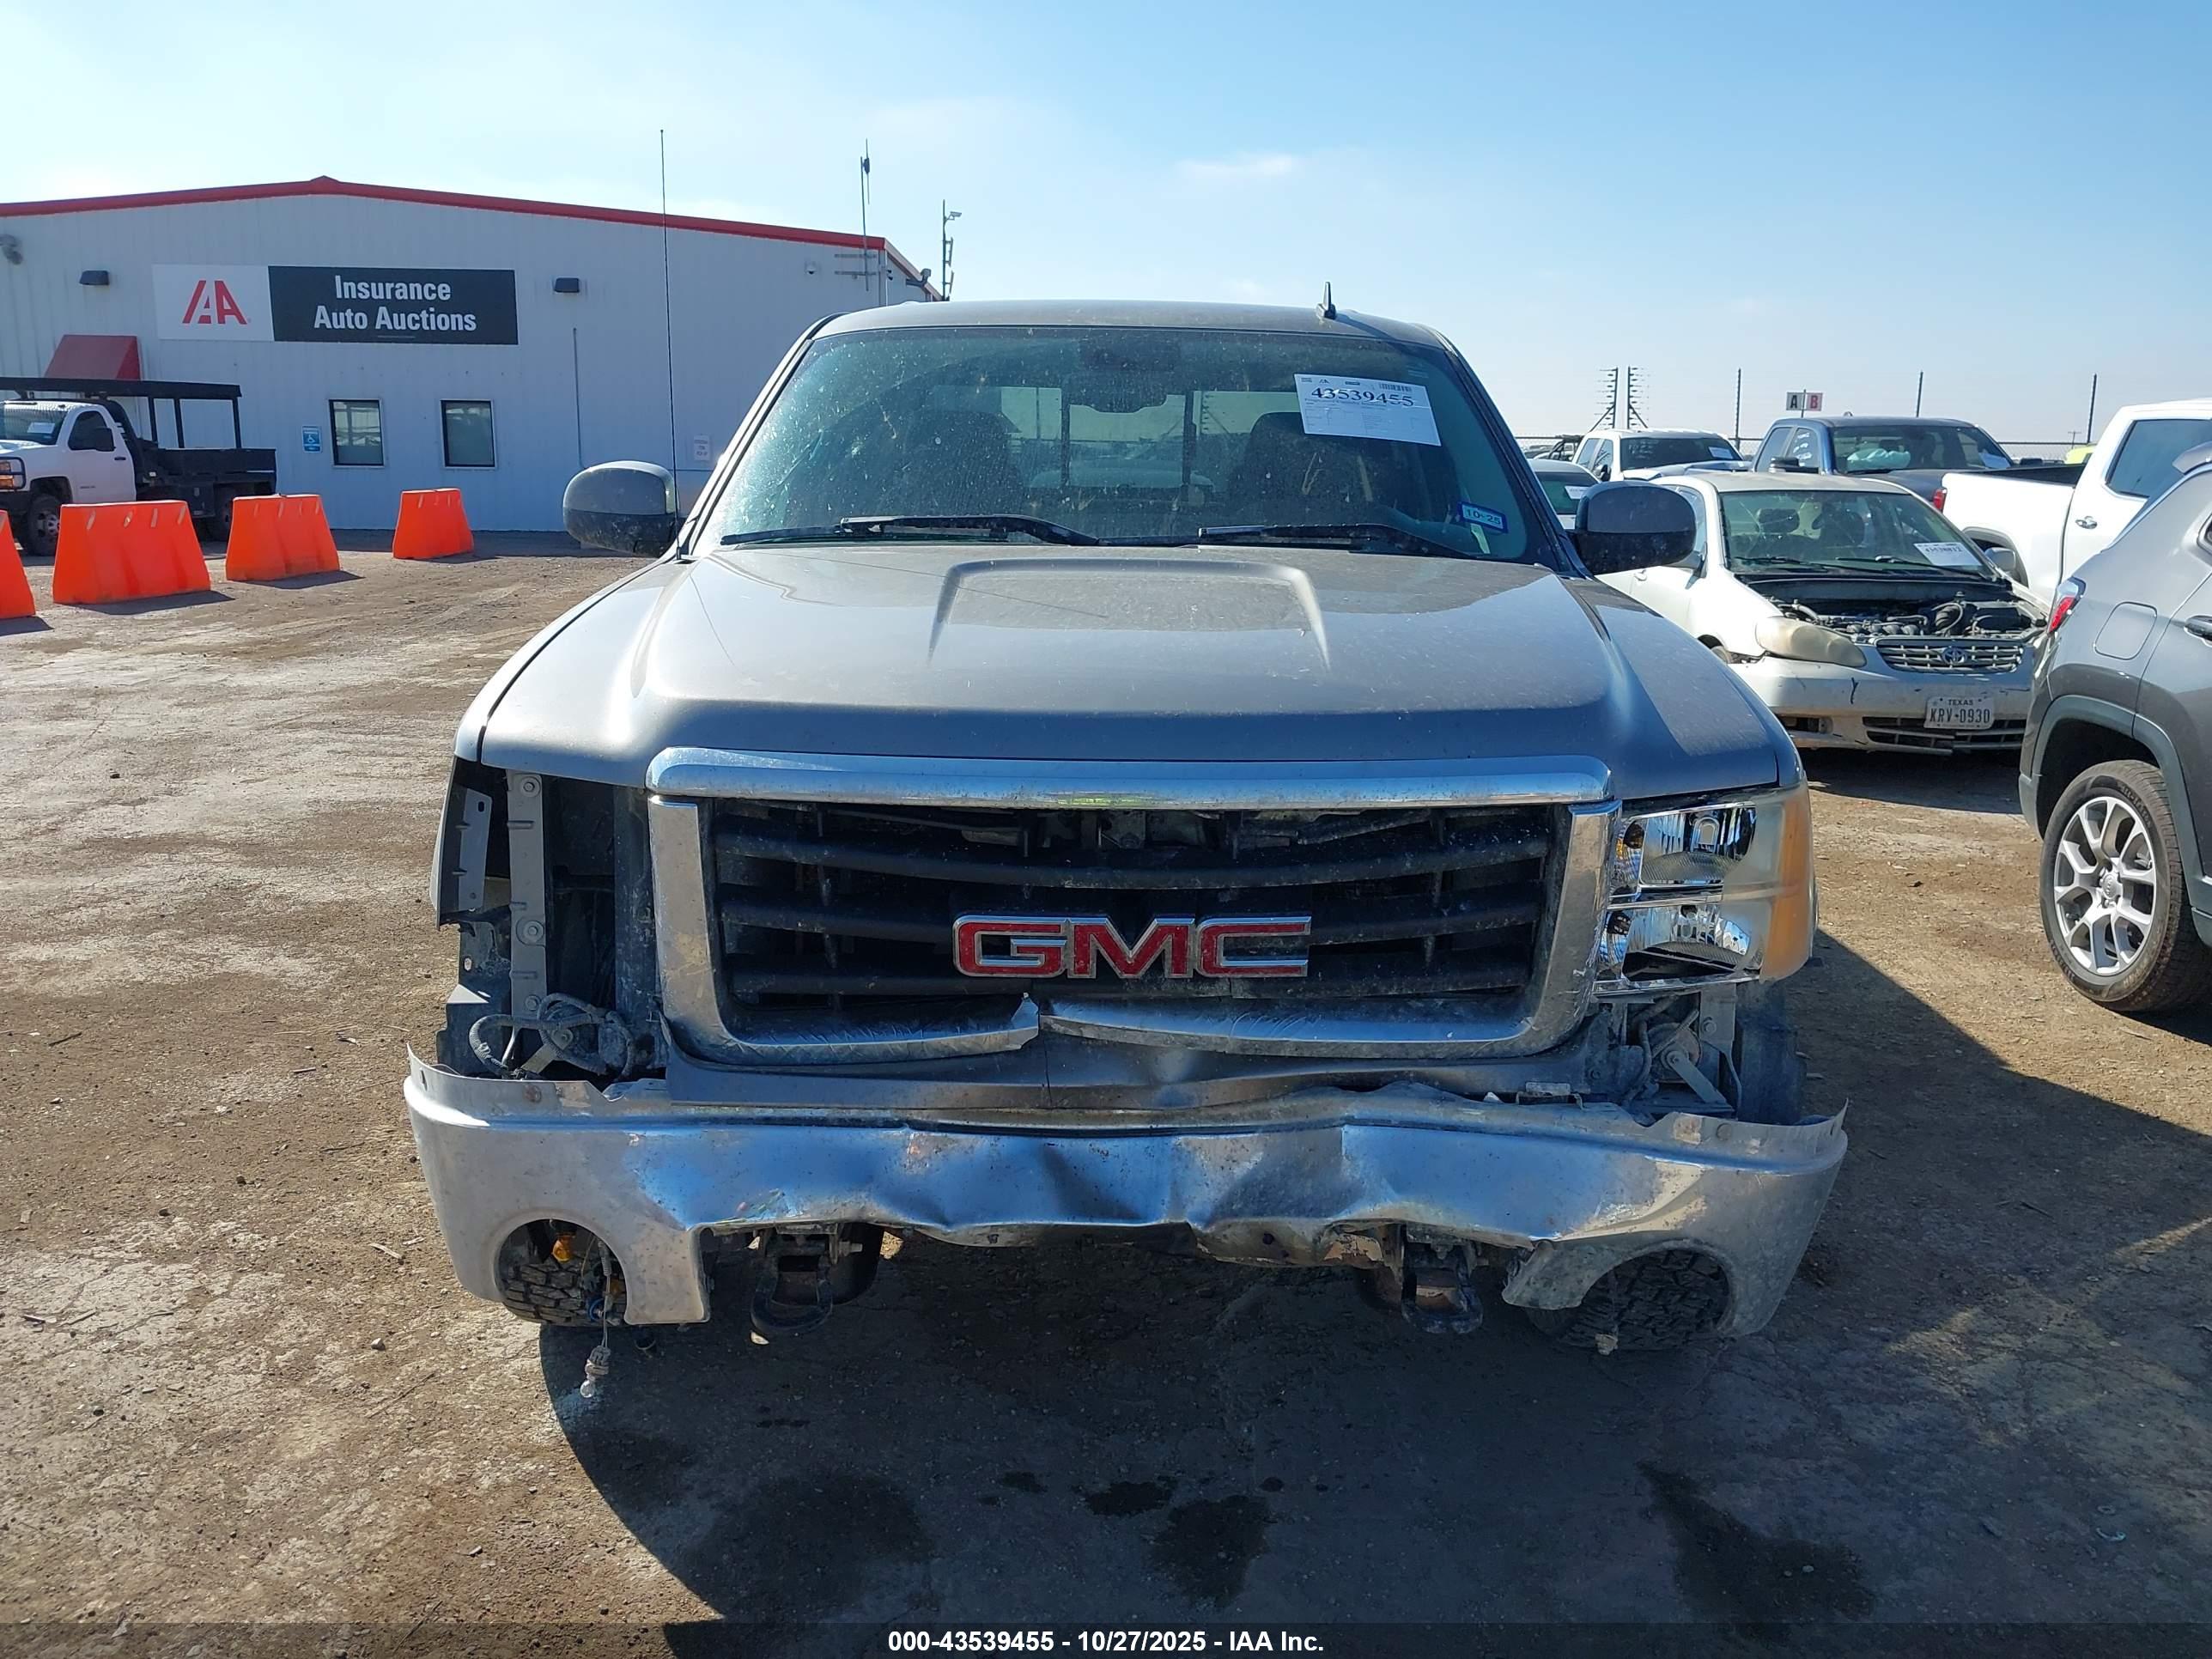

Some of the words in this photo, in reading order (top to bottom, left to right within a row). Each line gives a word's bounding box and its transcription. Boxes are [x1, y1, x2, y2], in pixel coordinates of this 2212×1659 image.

[335, 275, 451, 301] Insurance
[313, 305, 368, 330] Auto
[375, 307, 477, 331] Auctions
[1311, 387, 1414, 407] 43539455
[1790, 395, 1797, 409] A
[1810, 395, 1818, 409] B
[952, 915, 1312, 979] GMC
